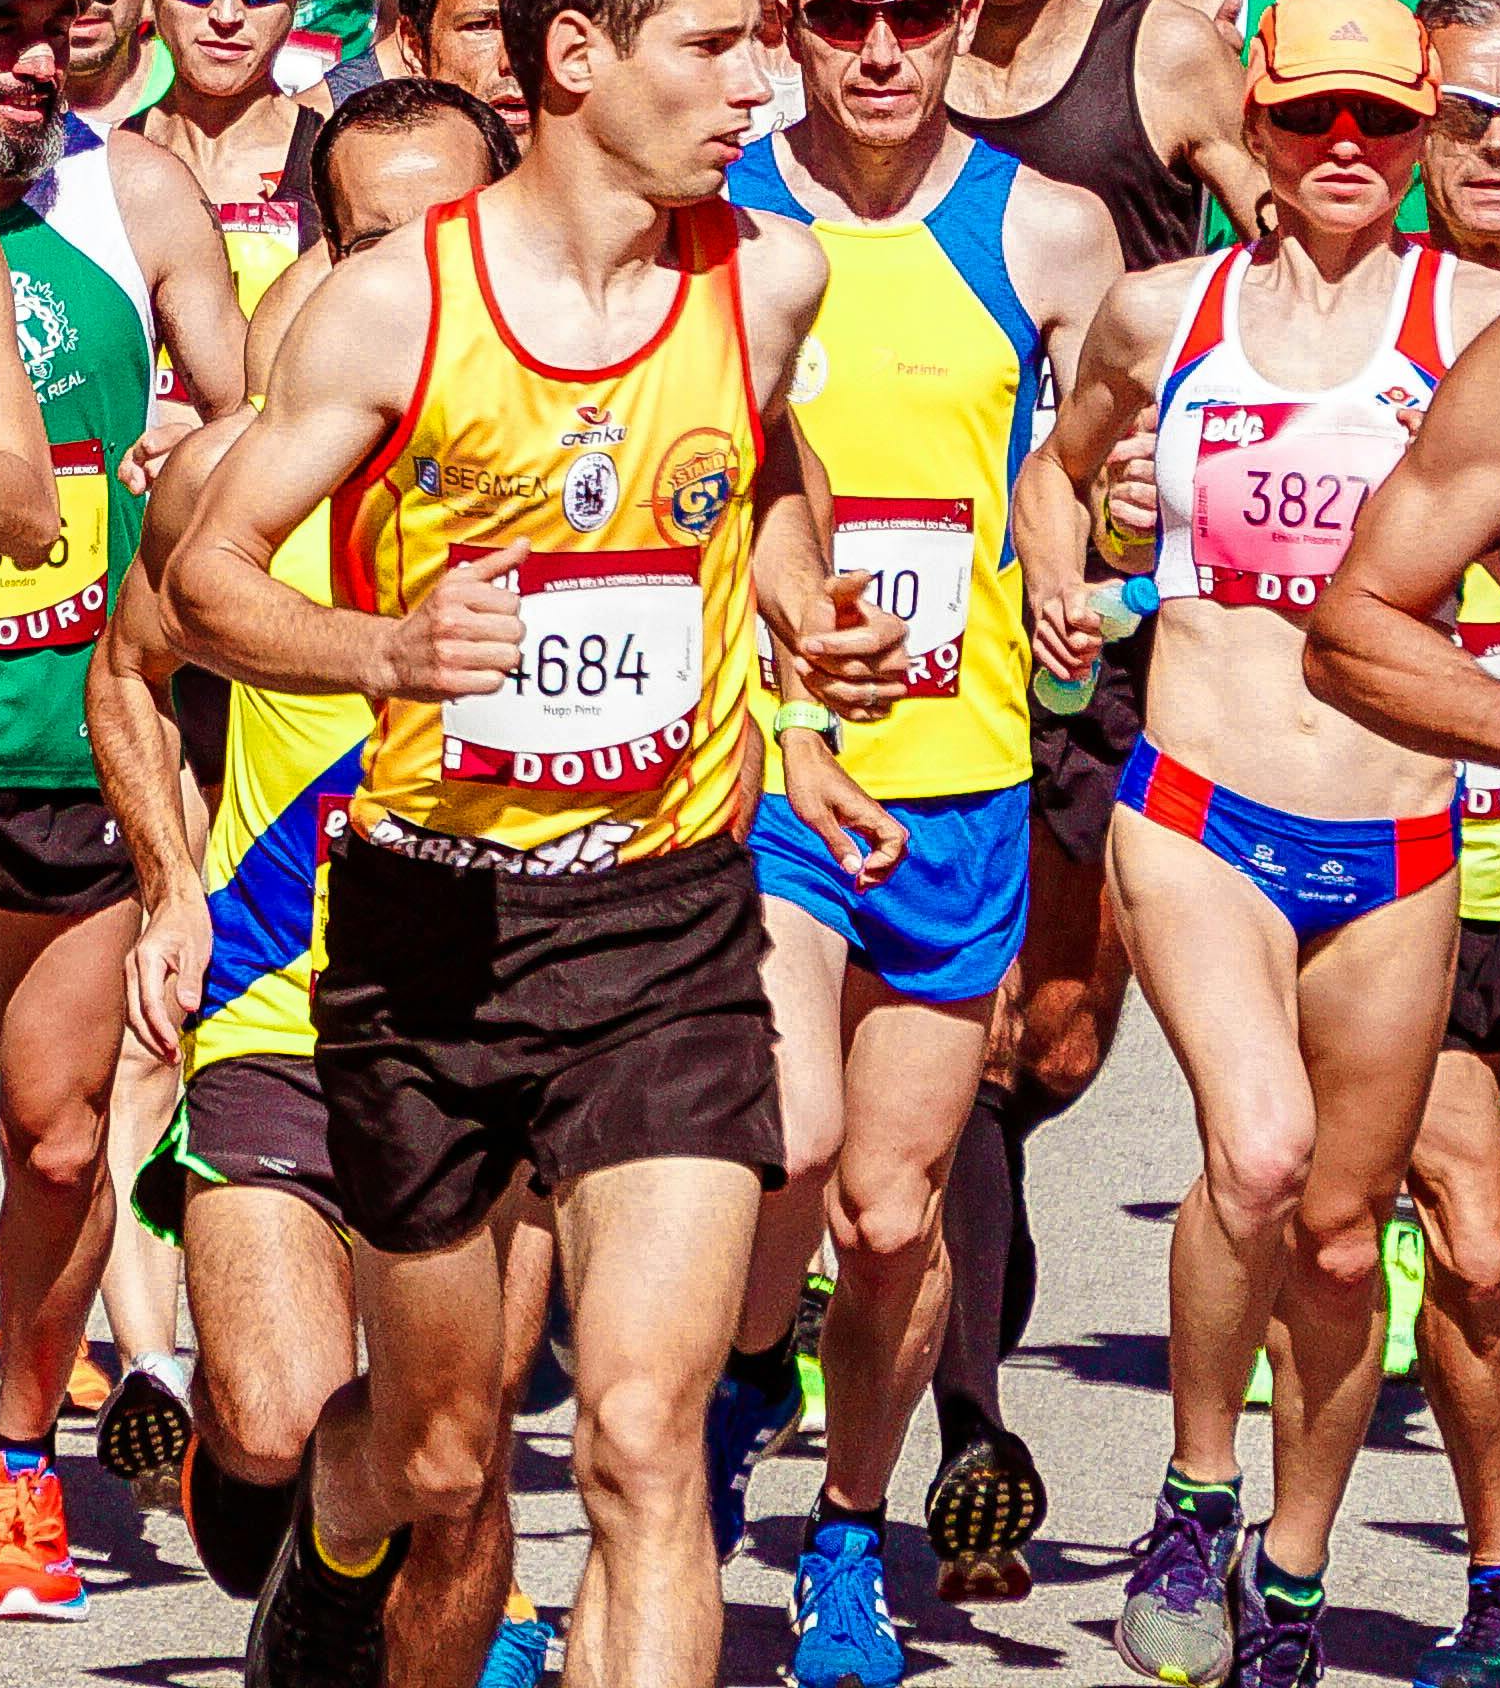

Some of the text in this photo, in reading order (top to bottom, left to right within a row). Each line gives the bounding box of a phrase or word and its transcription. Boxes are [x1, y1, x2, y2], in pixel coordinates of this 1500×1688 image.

[48, 370, 86, 400] REAL
[1242, 470, 1370, 531] 3827
[838, 569, 919, 620] 10
[543, 704, 572, 718] Hugo
[512, 718, 690, 785] DOURO
